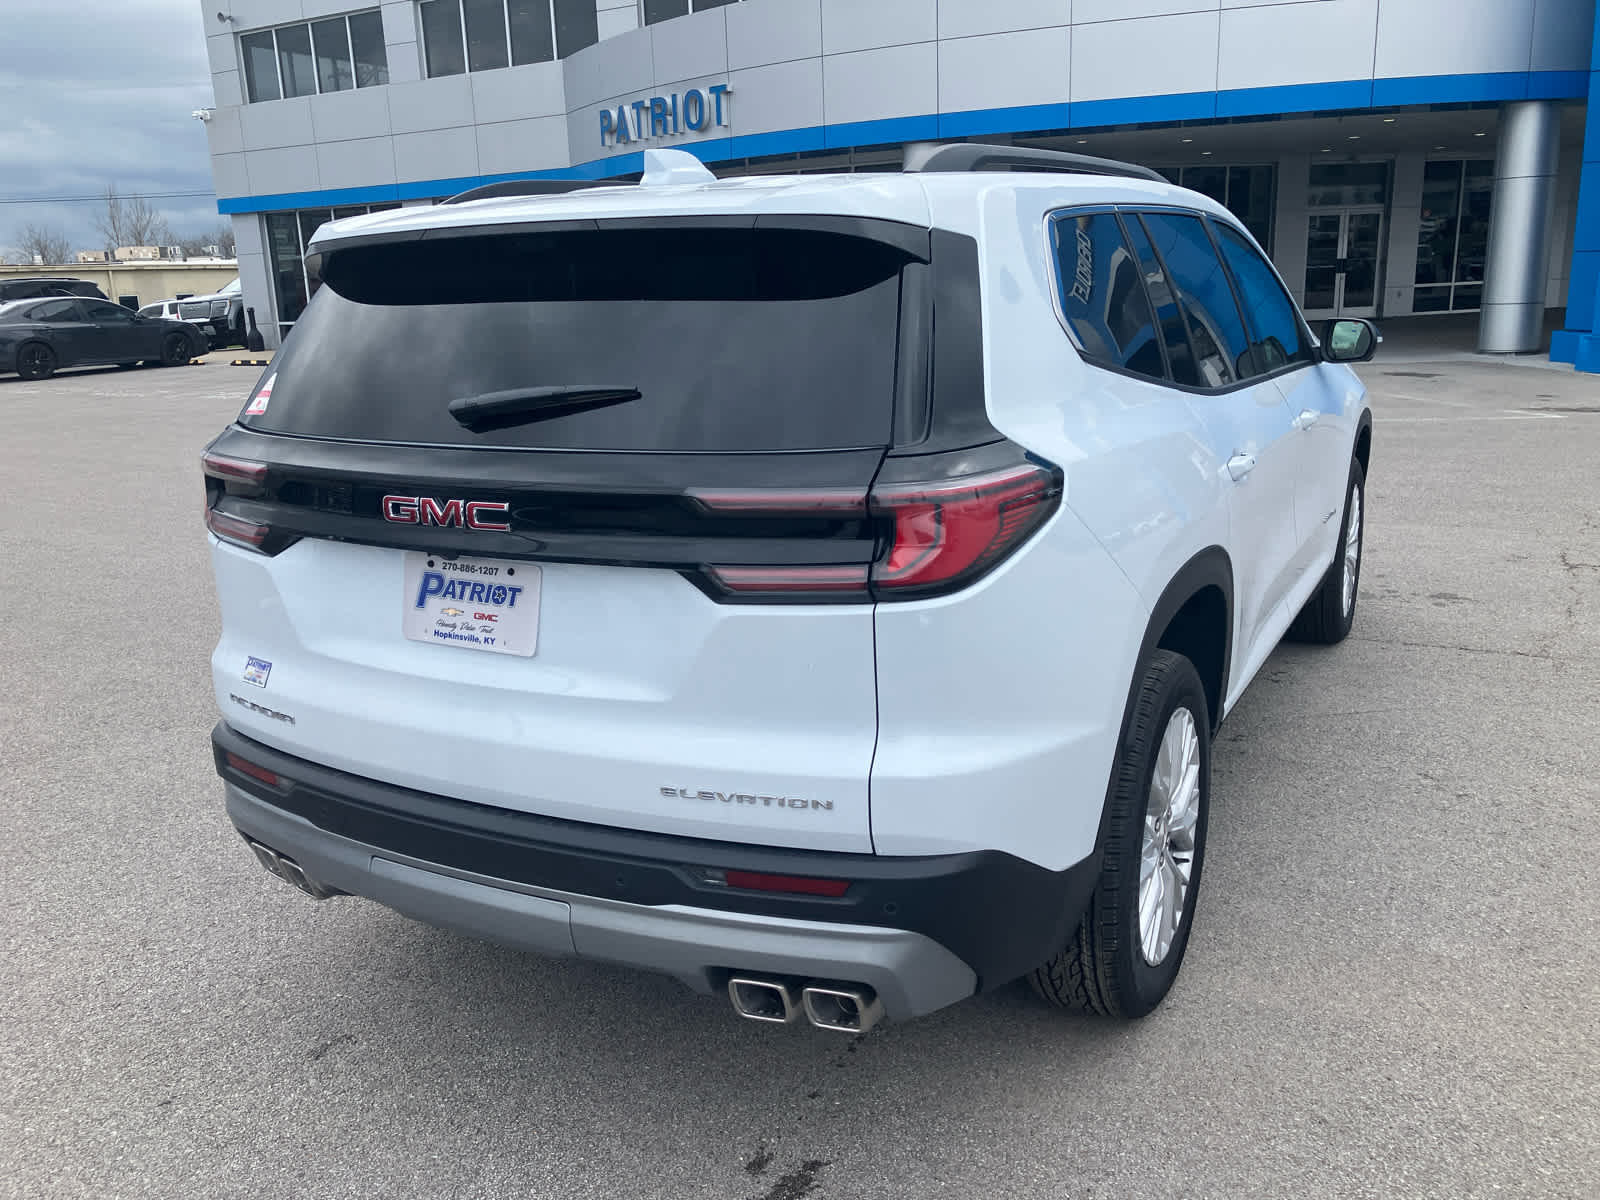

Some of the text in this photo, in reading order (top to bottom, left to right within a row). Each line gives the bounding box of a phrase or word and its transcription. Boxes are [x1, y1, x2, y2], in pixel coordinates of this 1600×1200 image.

[600, 84, 731, 147] PATRIOT
[382, 494, 511, 532] GMC
[441, 561, 500, 576] 270-886-1207
[415, 571, 523, 609] PATRIOT
[473, 612, 499, 623] GMC
[433, 629, 496, 645] Hopkinsville, KY
[659, 785, 834, 810] ELEVATION
